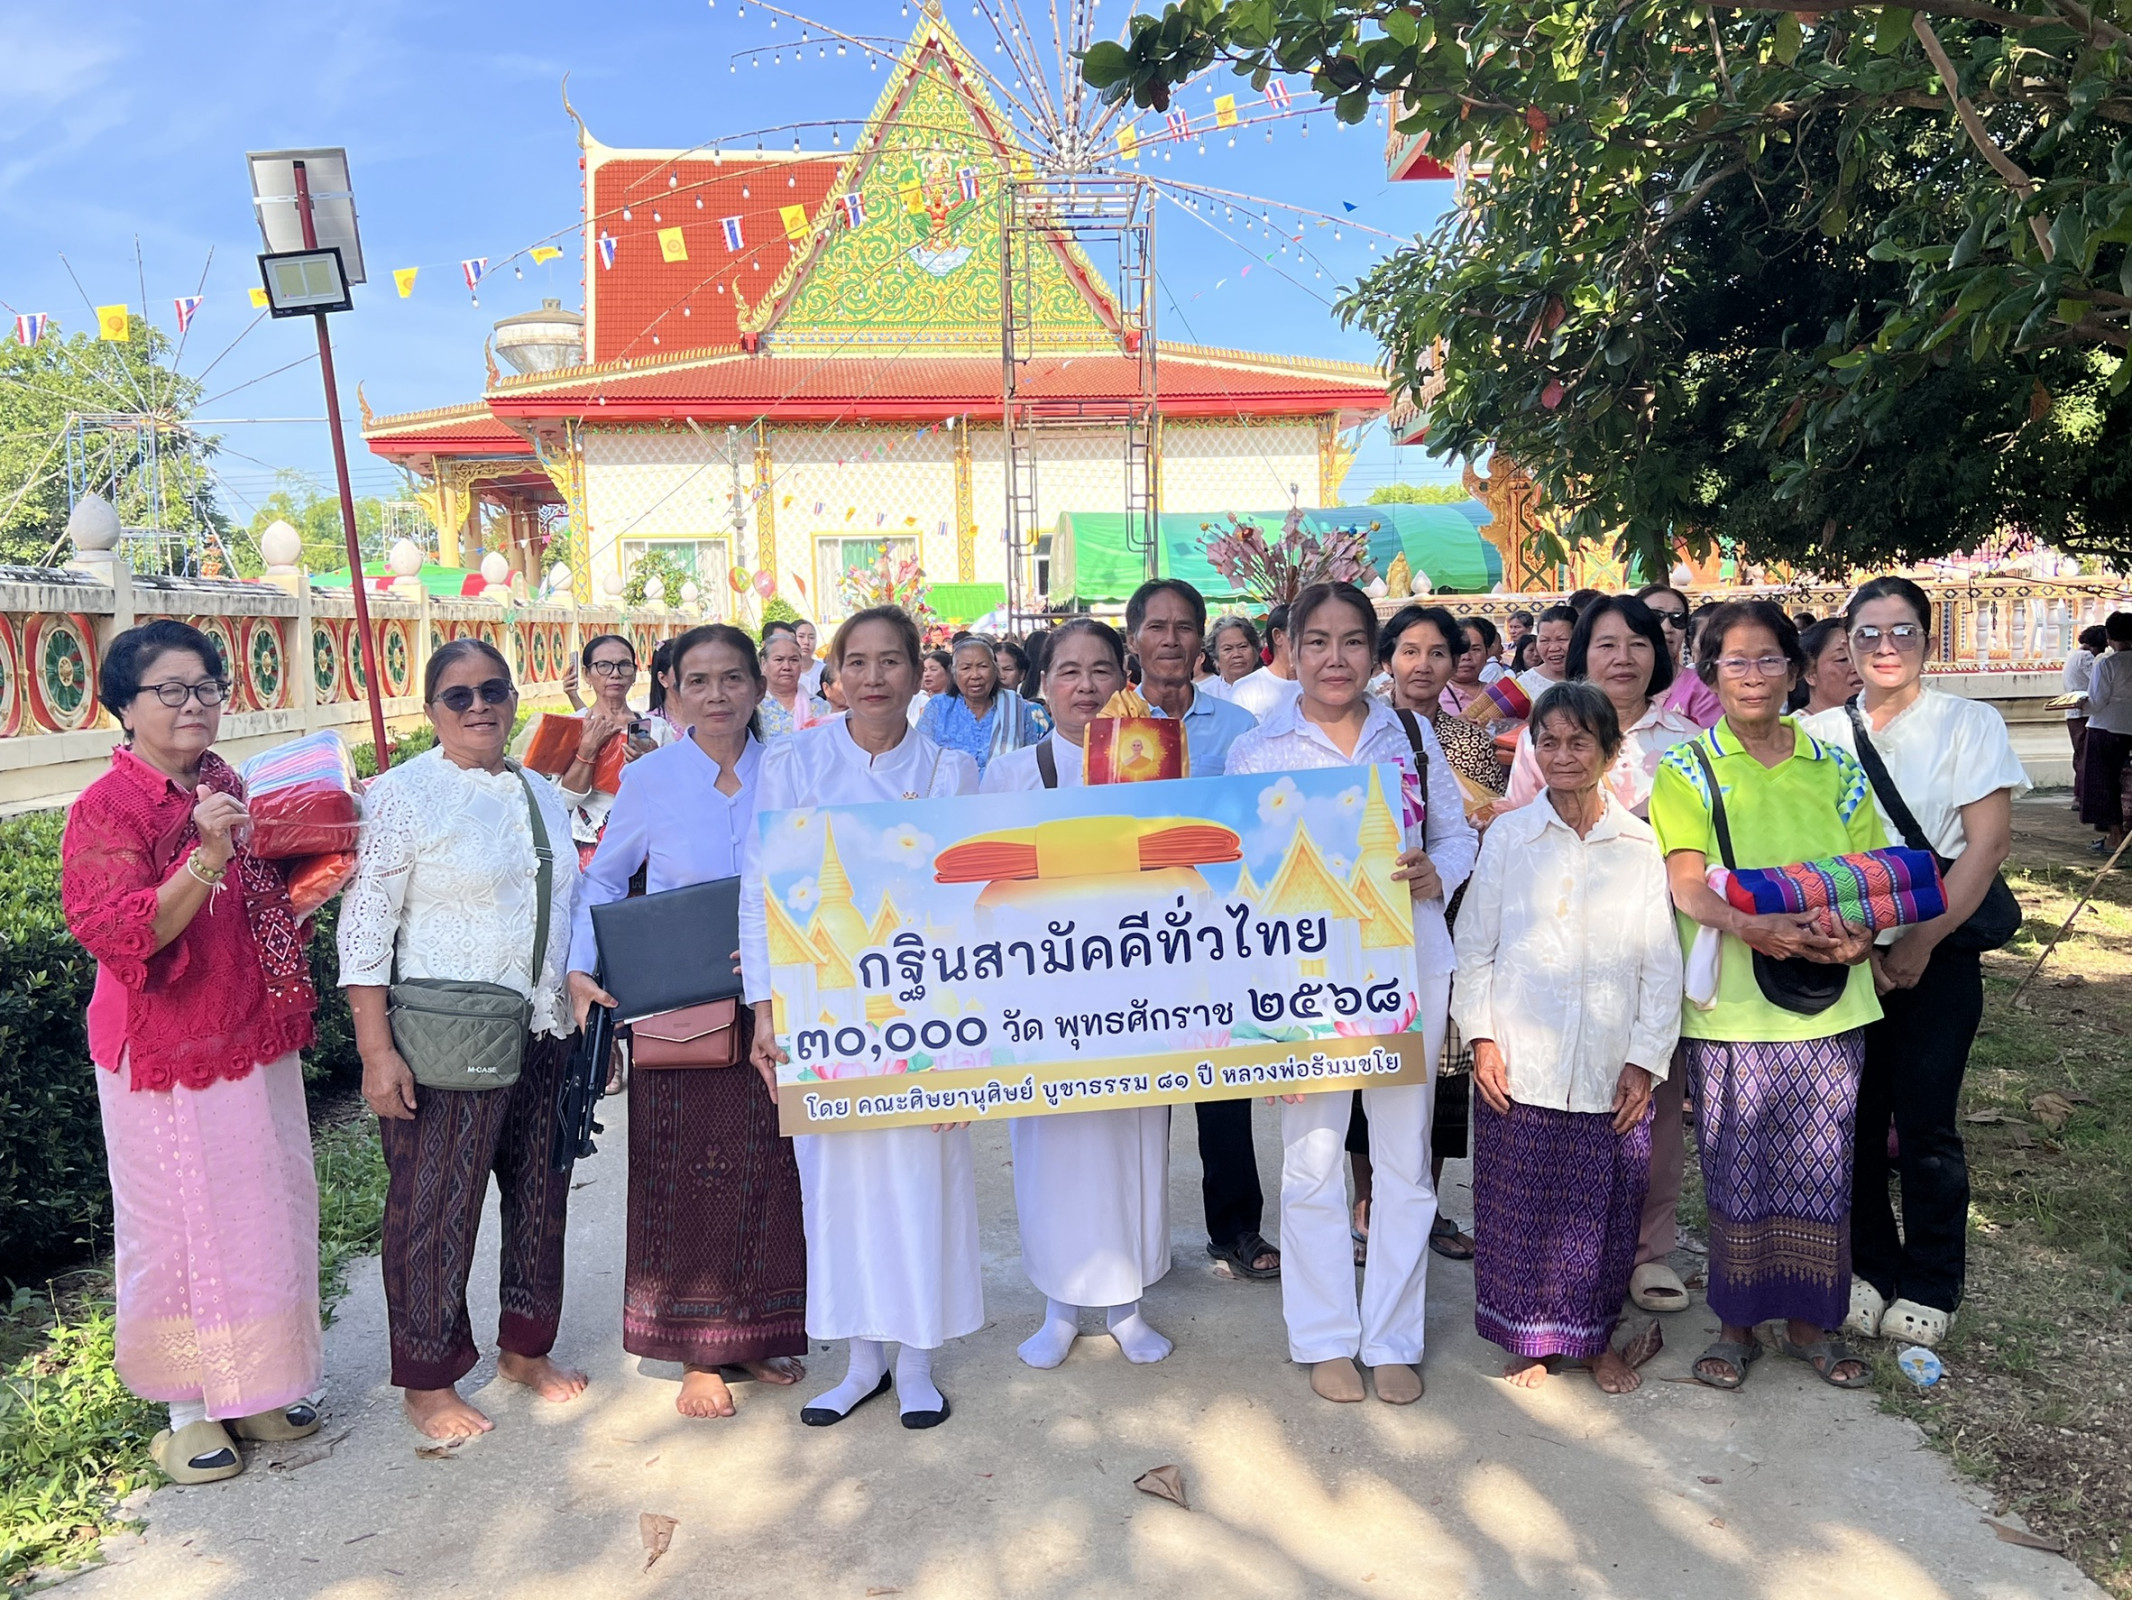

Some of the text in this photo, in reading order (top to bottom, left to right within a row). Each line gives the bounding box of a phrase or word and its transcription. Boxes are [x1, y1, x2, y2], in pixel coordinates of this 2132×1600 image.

[858, 894, 1328, 1002] กฐินสามัคคีทั่วไทย
[796, 977, 1402, 1062] ๓๐,๐๐๐ วัด พุทธศักราช ๒๕๖๘
[467, 1066, 497, 1074] M-CASE
[805, 1049, 1400, 1119] โดย คณะศิษยานุศิษย์ บูชาธรรม ๘๑ ปี หลวงพ่อธัมมชโย
